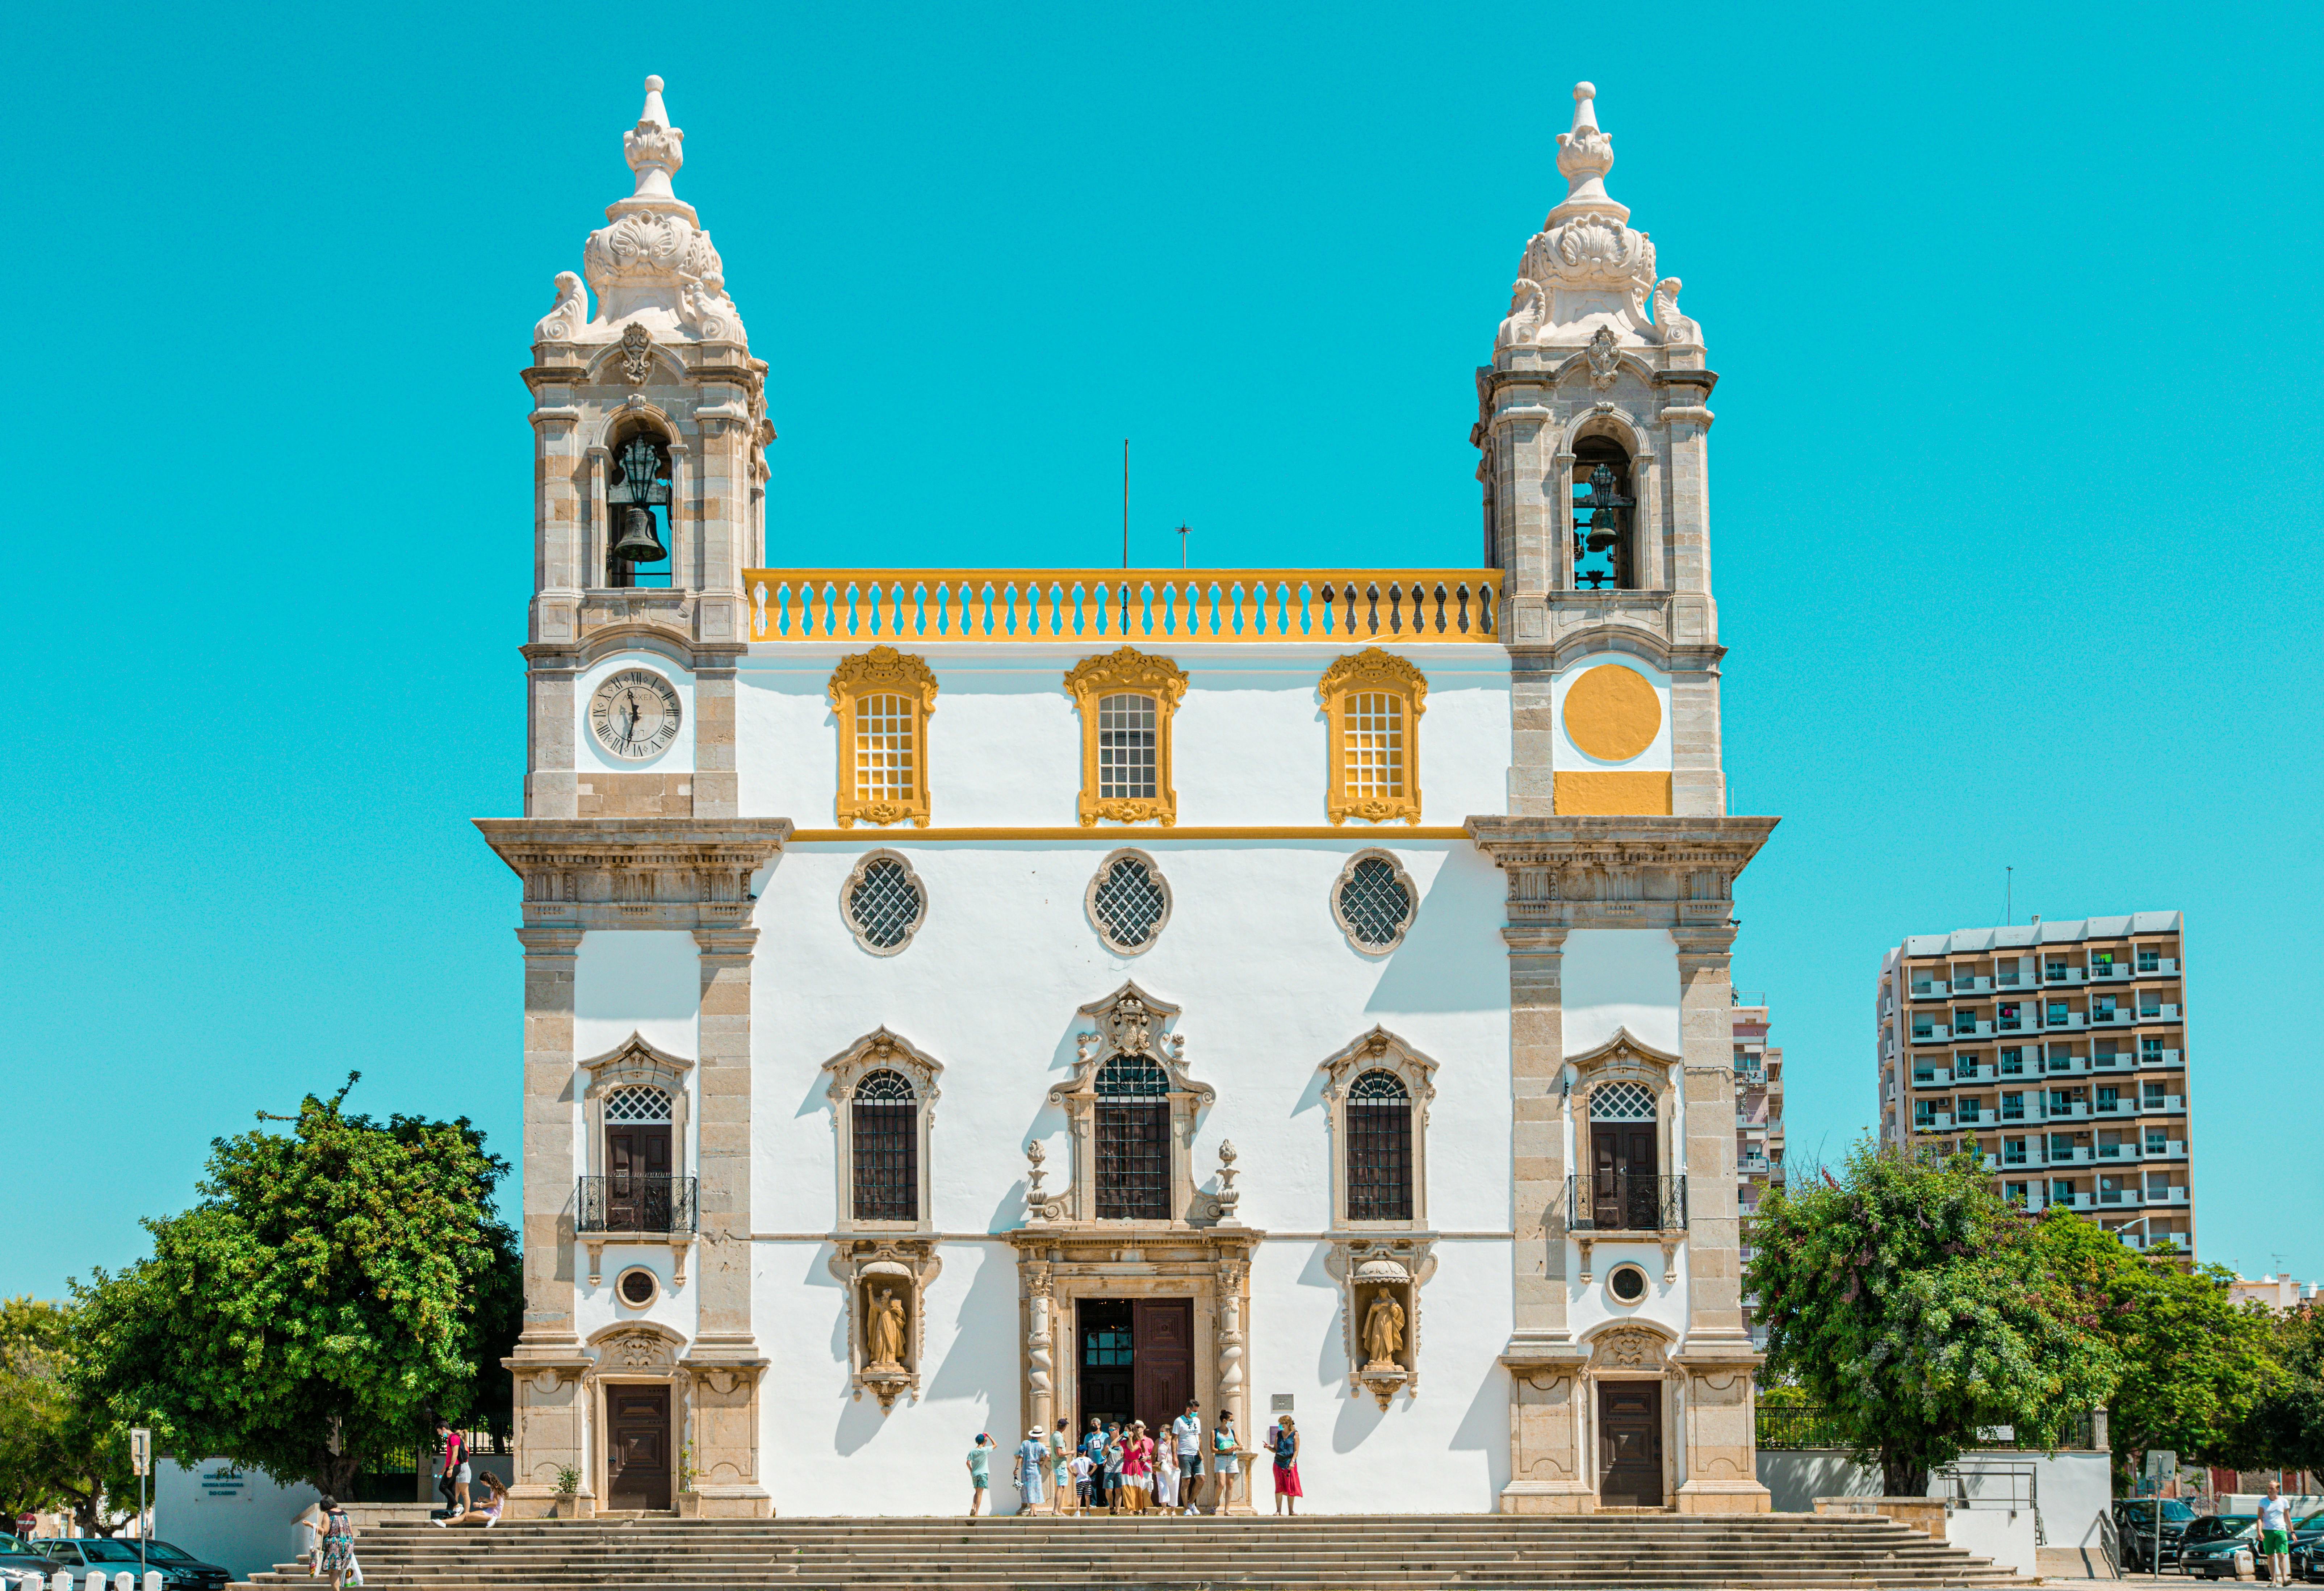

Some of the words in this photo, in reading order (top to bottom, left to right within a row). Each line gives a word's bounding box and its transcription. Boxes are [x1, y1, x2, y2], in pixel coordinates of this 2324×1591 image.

[610, 677, 623, 691] XI
[631, 672, 641, 685] XII
[598, 692, 611, 702] X
[661, 691, 675, 701] II
